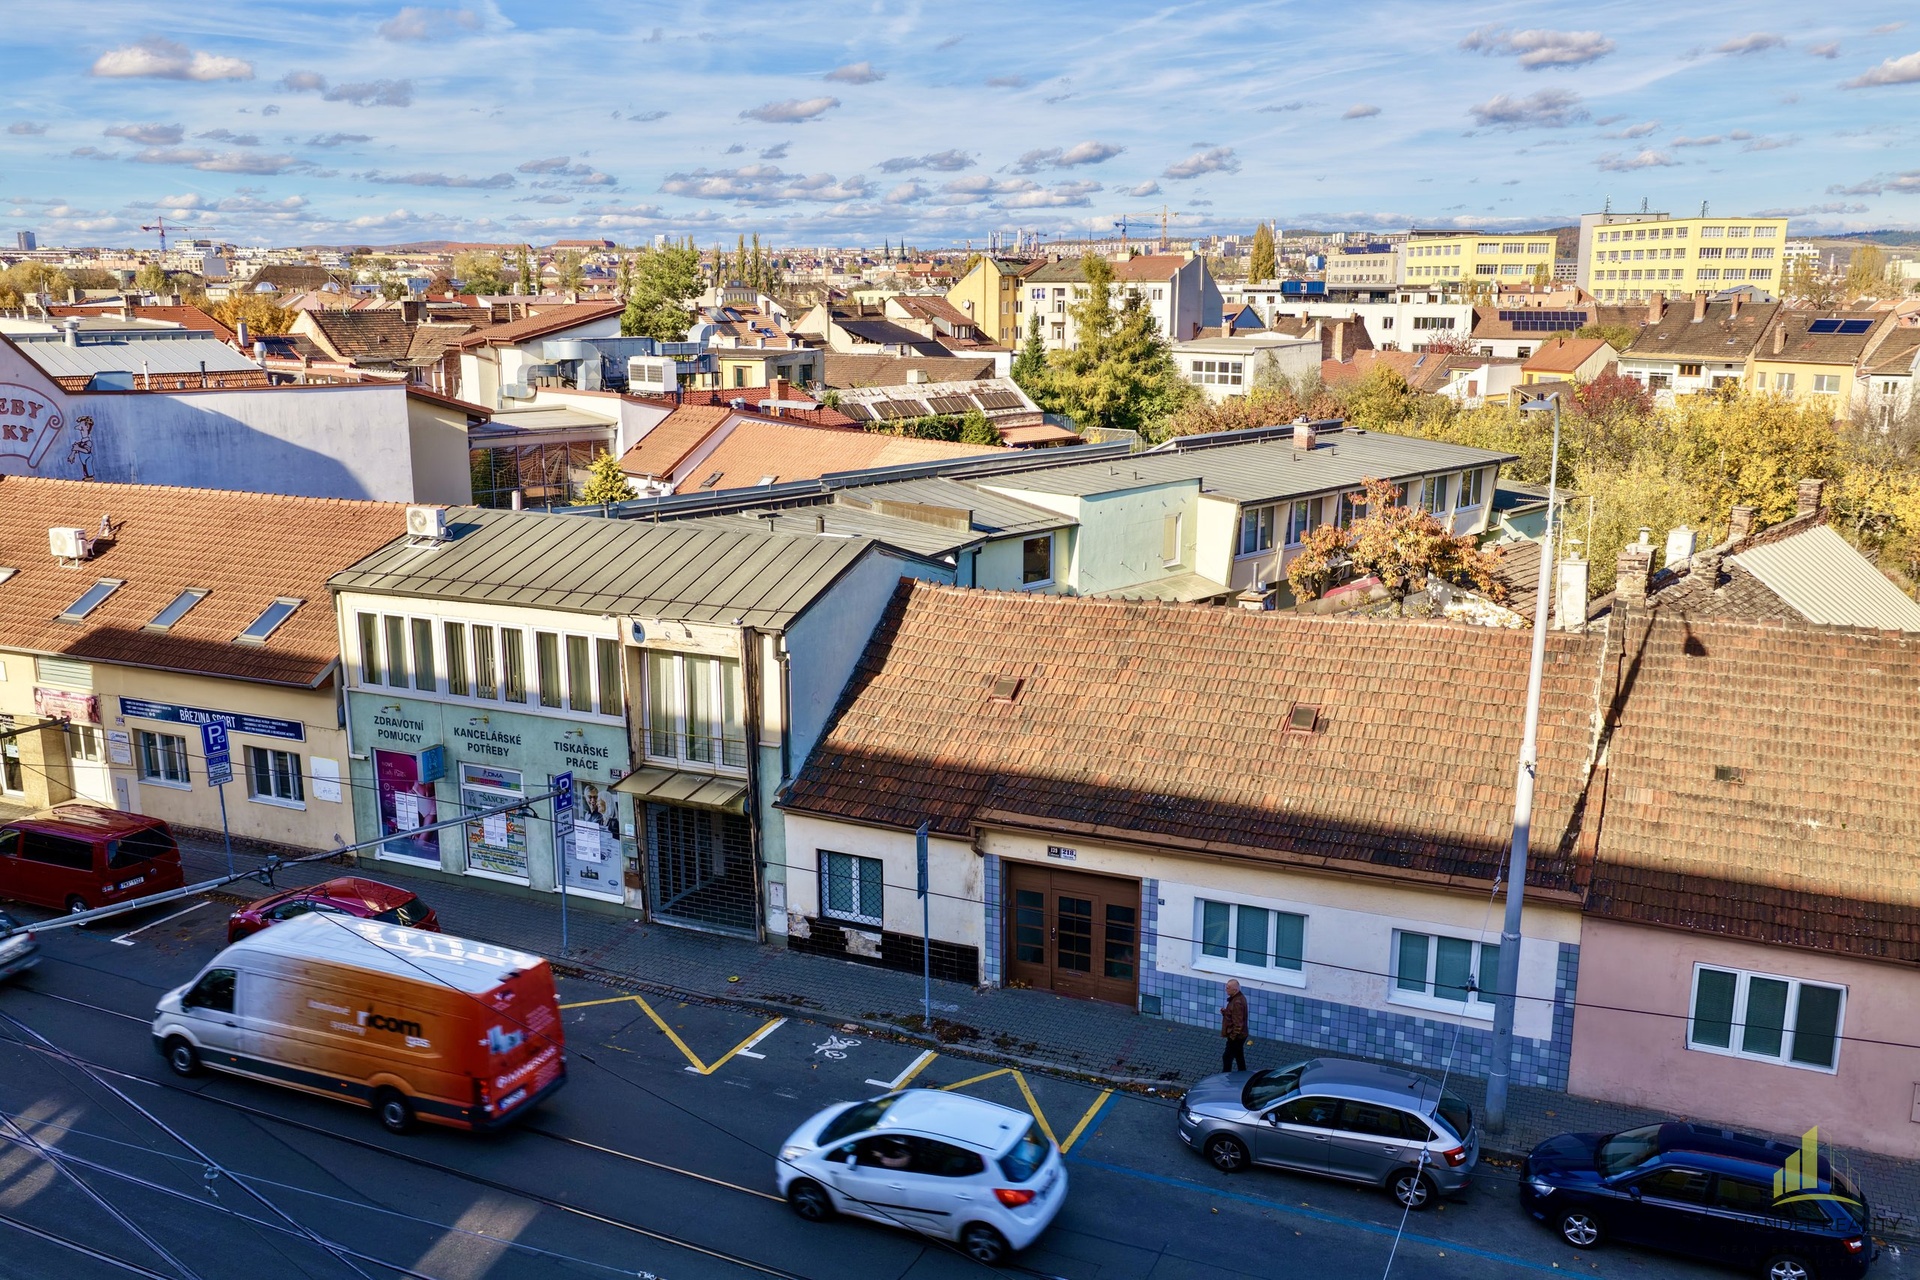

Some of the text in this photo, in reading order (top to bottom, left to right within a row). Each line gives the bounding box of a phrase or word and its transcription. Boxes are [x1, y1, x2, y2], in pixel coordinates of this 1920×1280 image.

[180, 708, 210, 723] BŘEZINA
[374, 716, 424, 731] ZDRAVOTNÍ
[208, 725, 221, 744] P
[454, 727, 521, 745] KANCELÁŘSKÉ
[467, 743, 509, 756] POTŘEBY
[554, 742, 608, 757] TISKAŘSKÉ
[566, 757, 598, 770] PRÁCE
